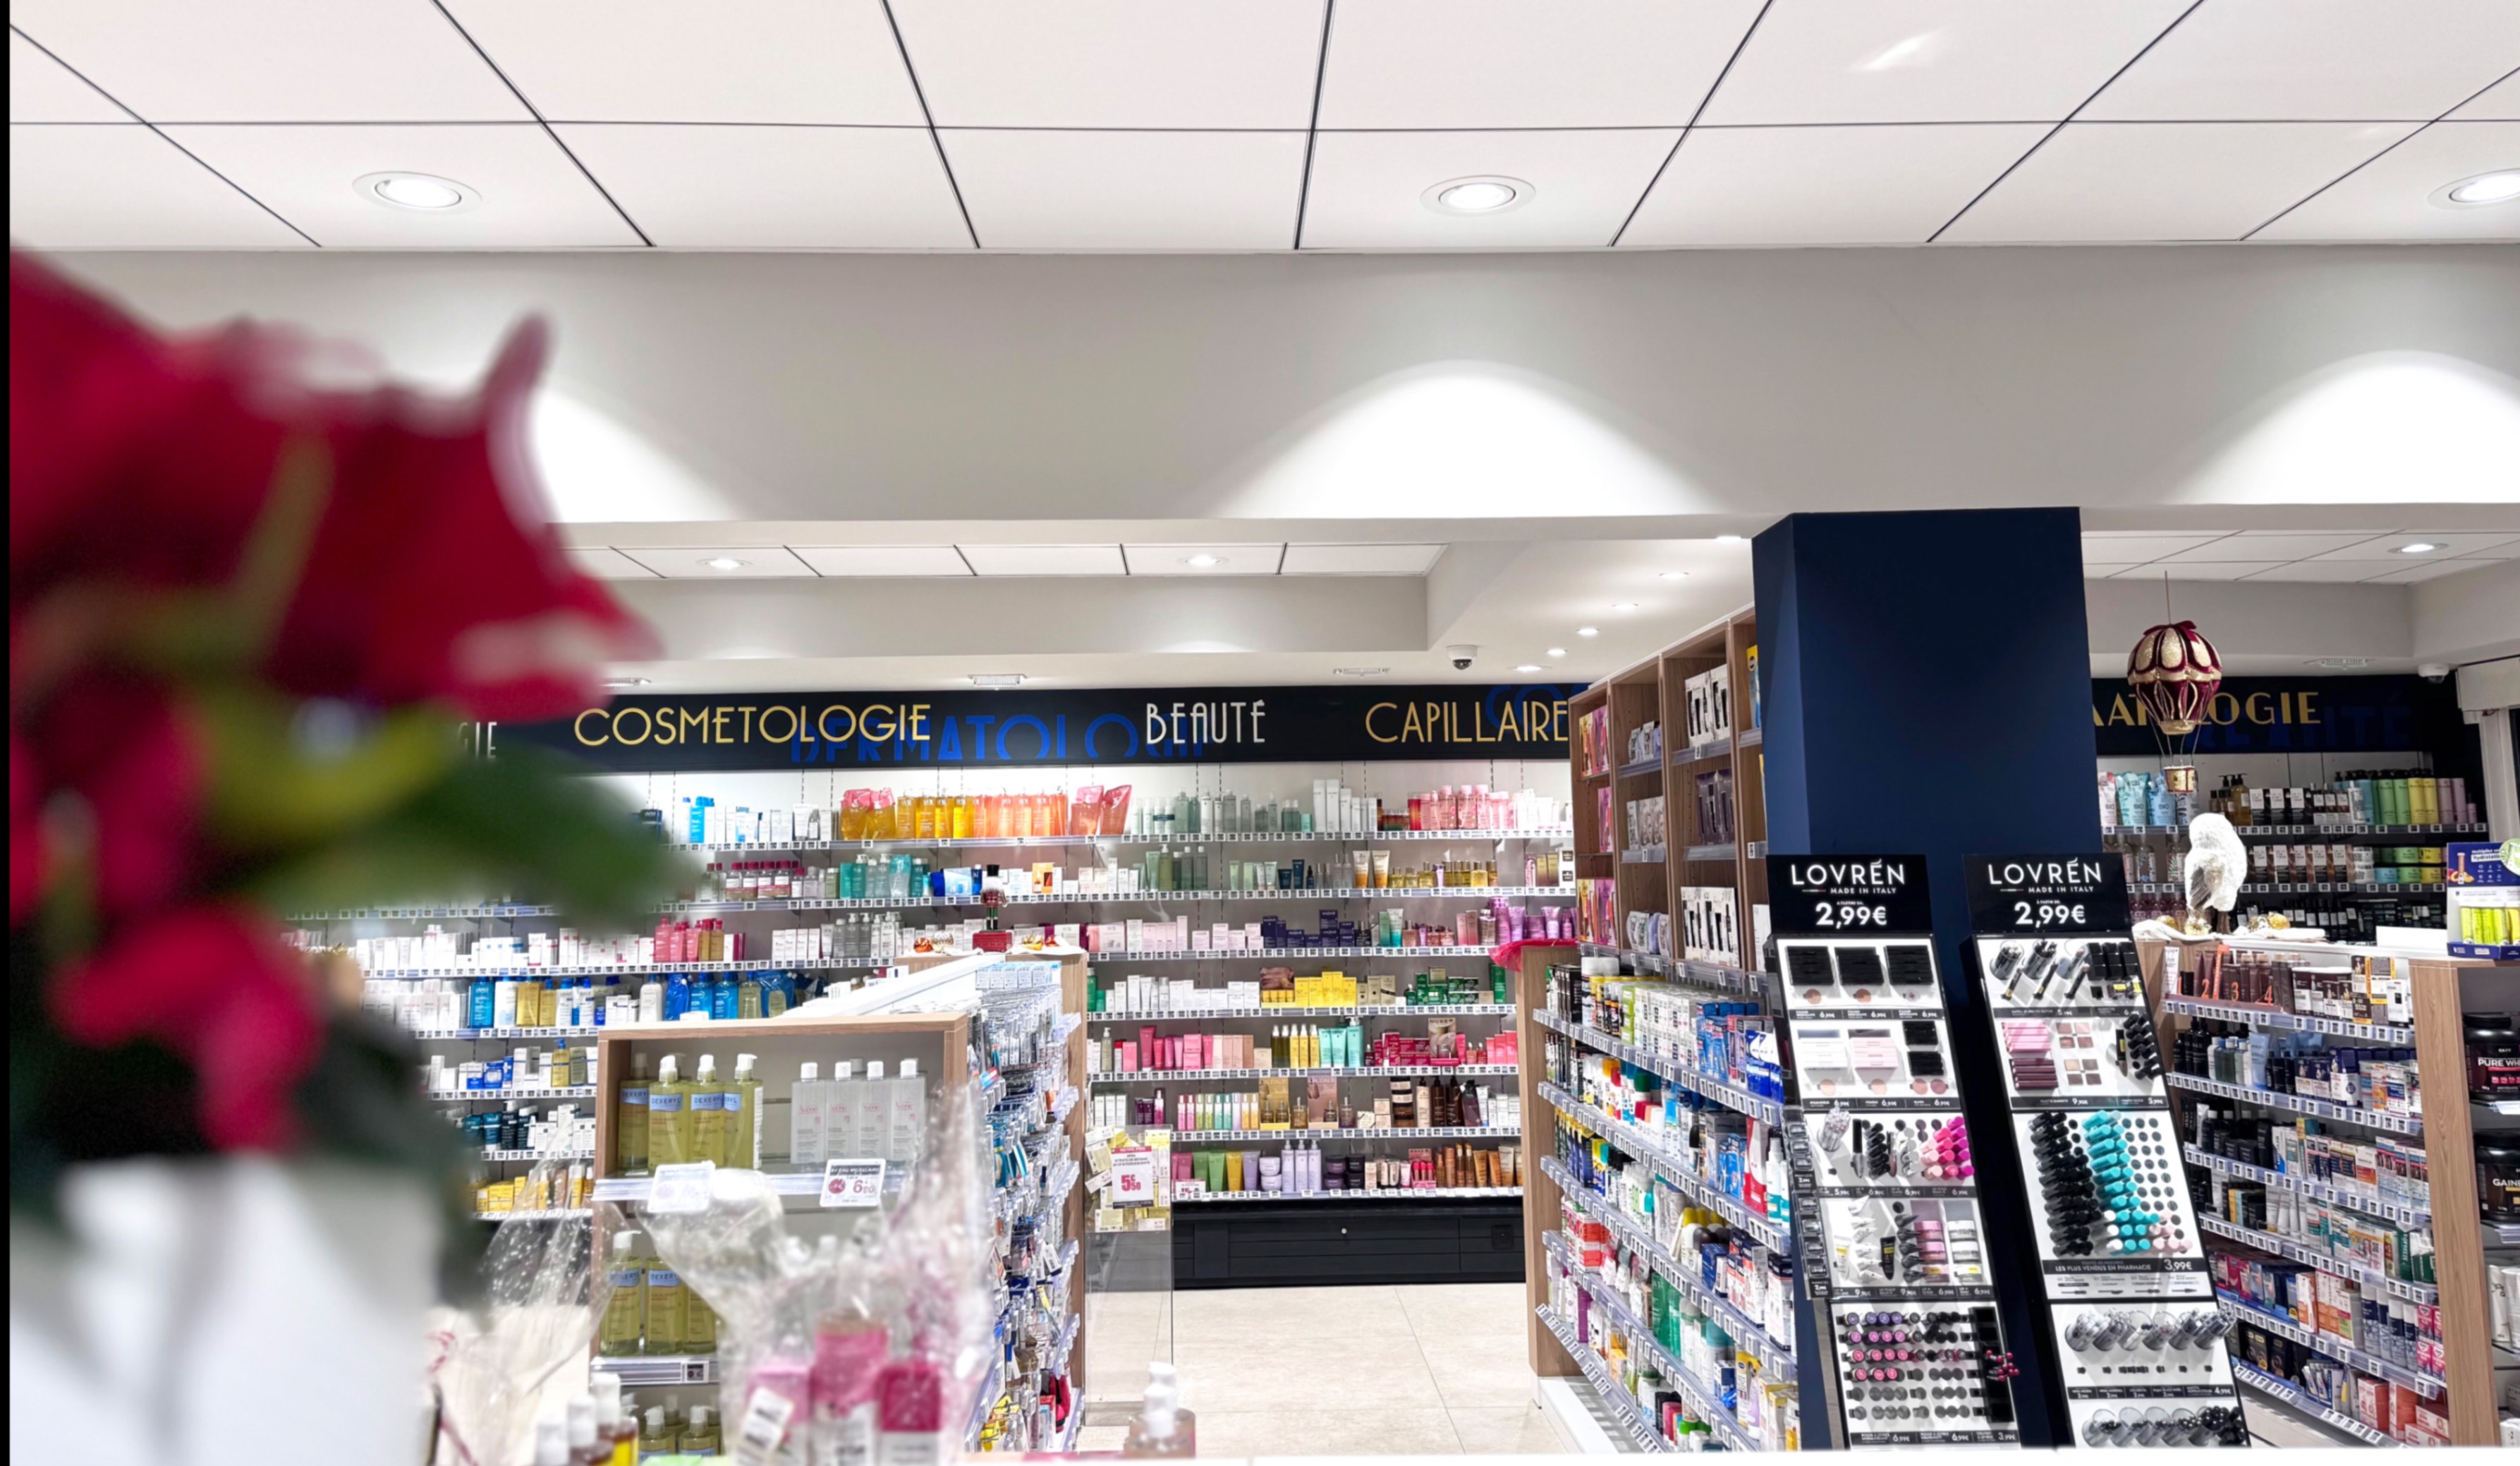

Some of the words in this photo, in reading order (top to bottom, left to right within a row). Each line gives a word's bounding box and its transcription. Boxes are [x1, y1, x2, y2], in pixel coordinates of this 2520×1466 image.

[574, 703, 931, 746] COSMETOLOGIE
[1146, 699, 1266, 745] BEAUTÉ
[1365, 701, 1569, 742] CAPILLAIRE
[1791, 859, 1905, 885] LOVRÉN
[1988, 857, 2102, 885] LOVRÉN
[1815, 902, 1887, 929] 2,99€
[2014, 901, 2086, 928] 2,99€
[2201, 979, 2210, 1000] 2
[2232, 981, 2239, 1002] 3
[2264, 986, 2273, 1005] 4
[2478, 1058, 2504, 1067] PURE
[2164, 1259, 2193, 1272] 3,99€
